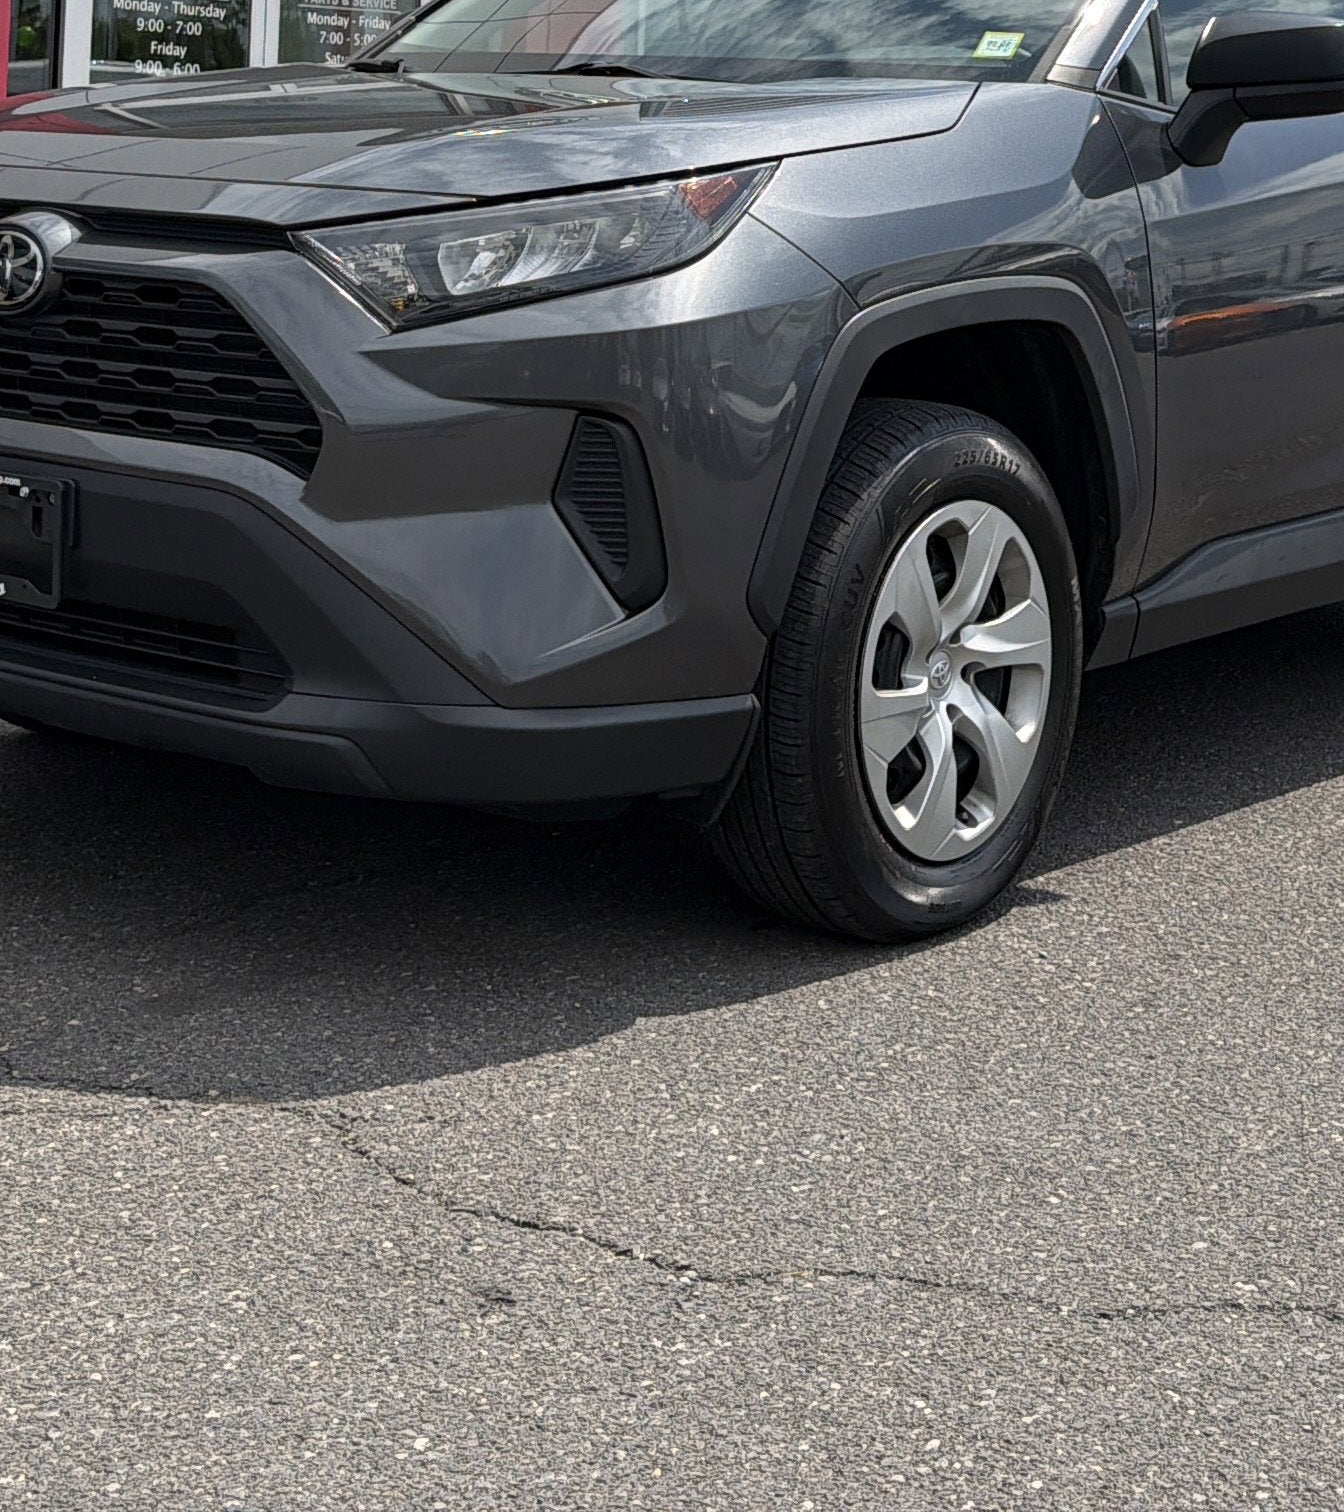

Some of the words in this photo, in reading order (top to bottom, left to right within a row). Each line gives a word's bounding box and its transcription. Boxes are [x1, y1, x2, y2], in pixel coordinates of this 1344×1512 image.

[172, 1, 227, 21] Thursday
[137, 18, 164, 33] 9:00
[176, 21, 203, 36] 7:00
[307, 12, 350, 29] Monday
[358, 15, 392, 31] Friday
[319, 31, 344, 45] 7:00
[150, 41, 188, 62] Friday
[135, 59, 163, 75] 9:00
[174, 62, 201, 75] 6:00
